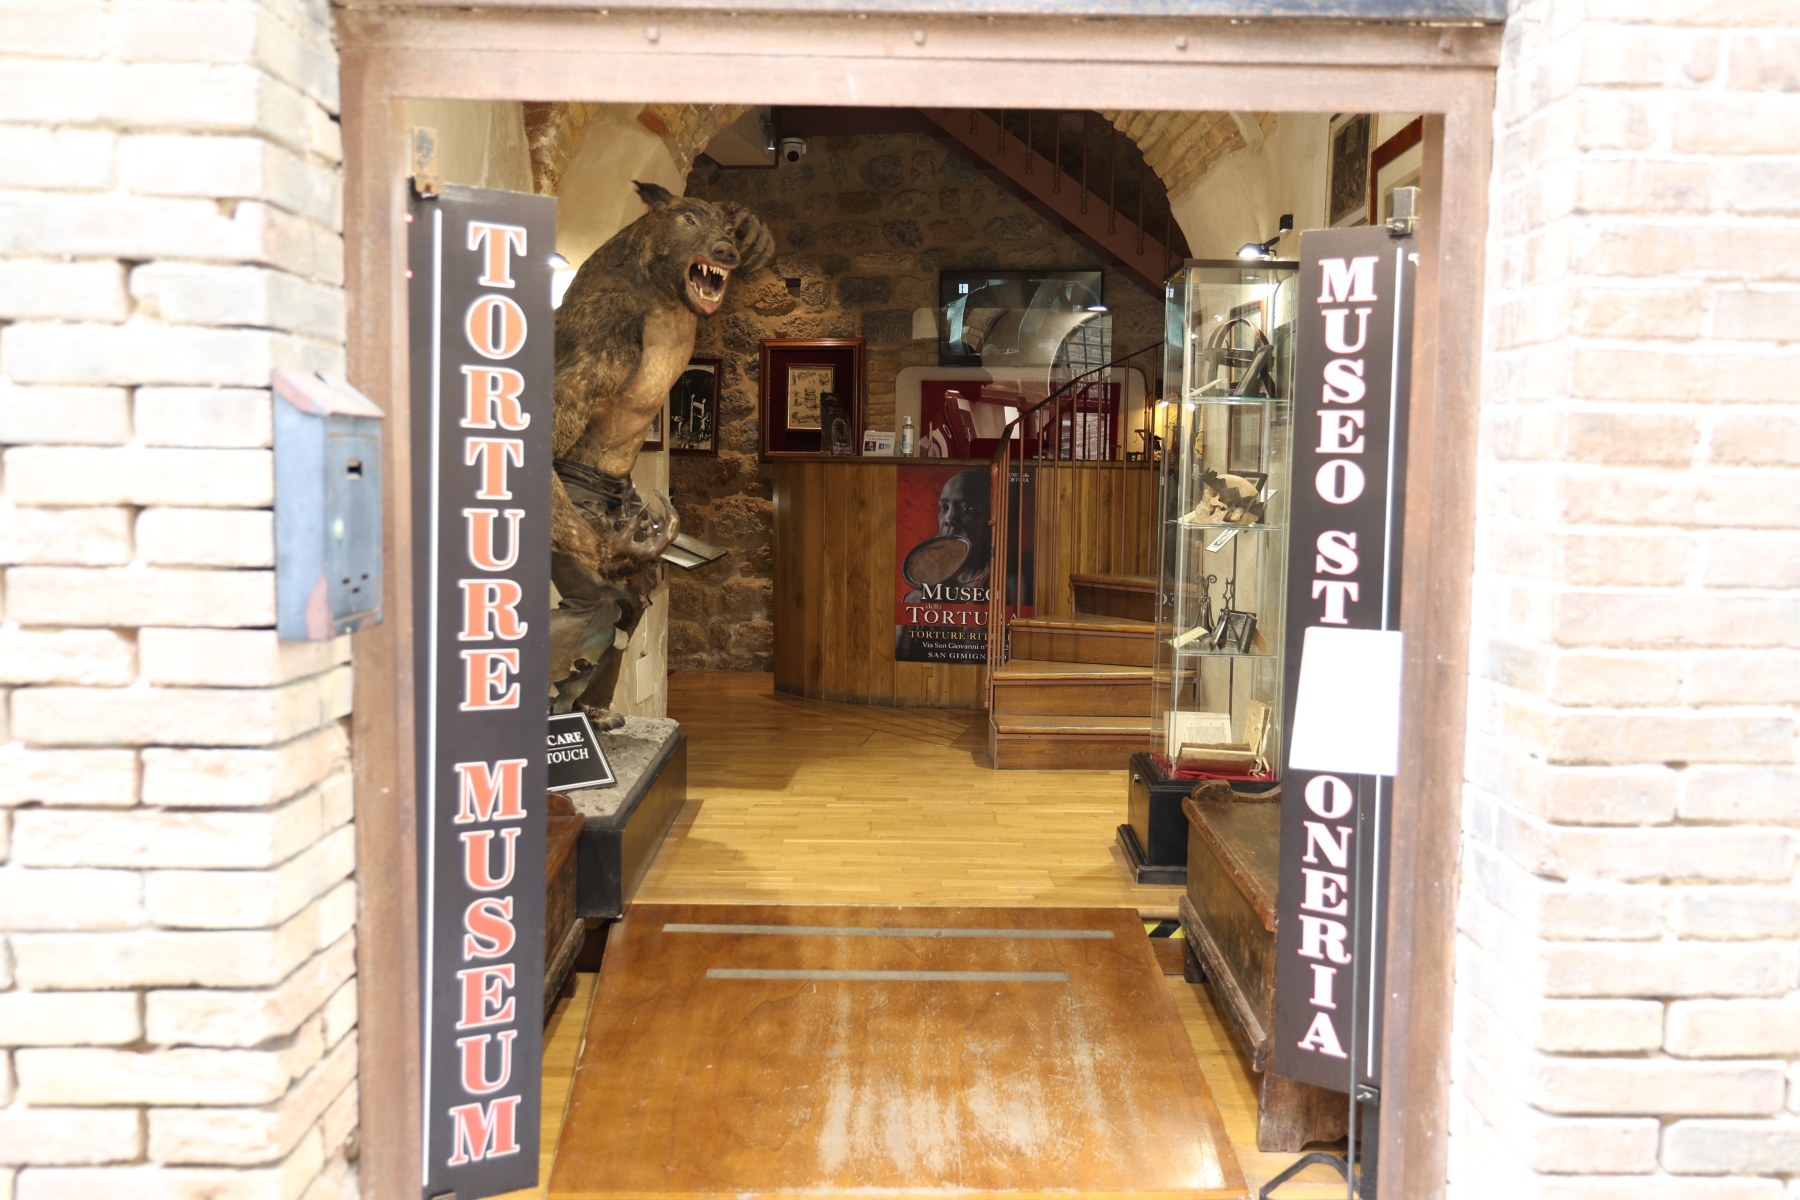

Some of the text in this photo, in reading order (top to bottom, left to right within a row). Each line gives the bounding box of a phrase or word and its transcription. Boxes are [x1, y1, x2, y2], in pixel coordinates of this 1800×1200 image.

[1314, 255, 1379, 506] MUSEO
[925, 602, 942, 610] della
[909, 630, 966, 640] TORTURE
[922, 641, 934, 649] Via
[948, 642, 979, 650] Giovanni
[447, 220, 531, 1168] TORTURE MUSEUM
[547, 731, 584, 745] CARE
